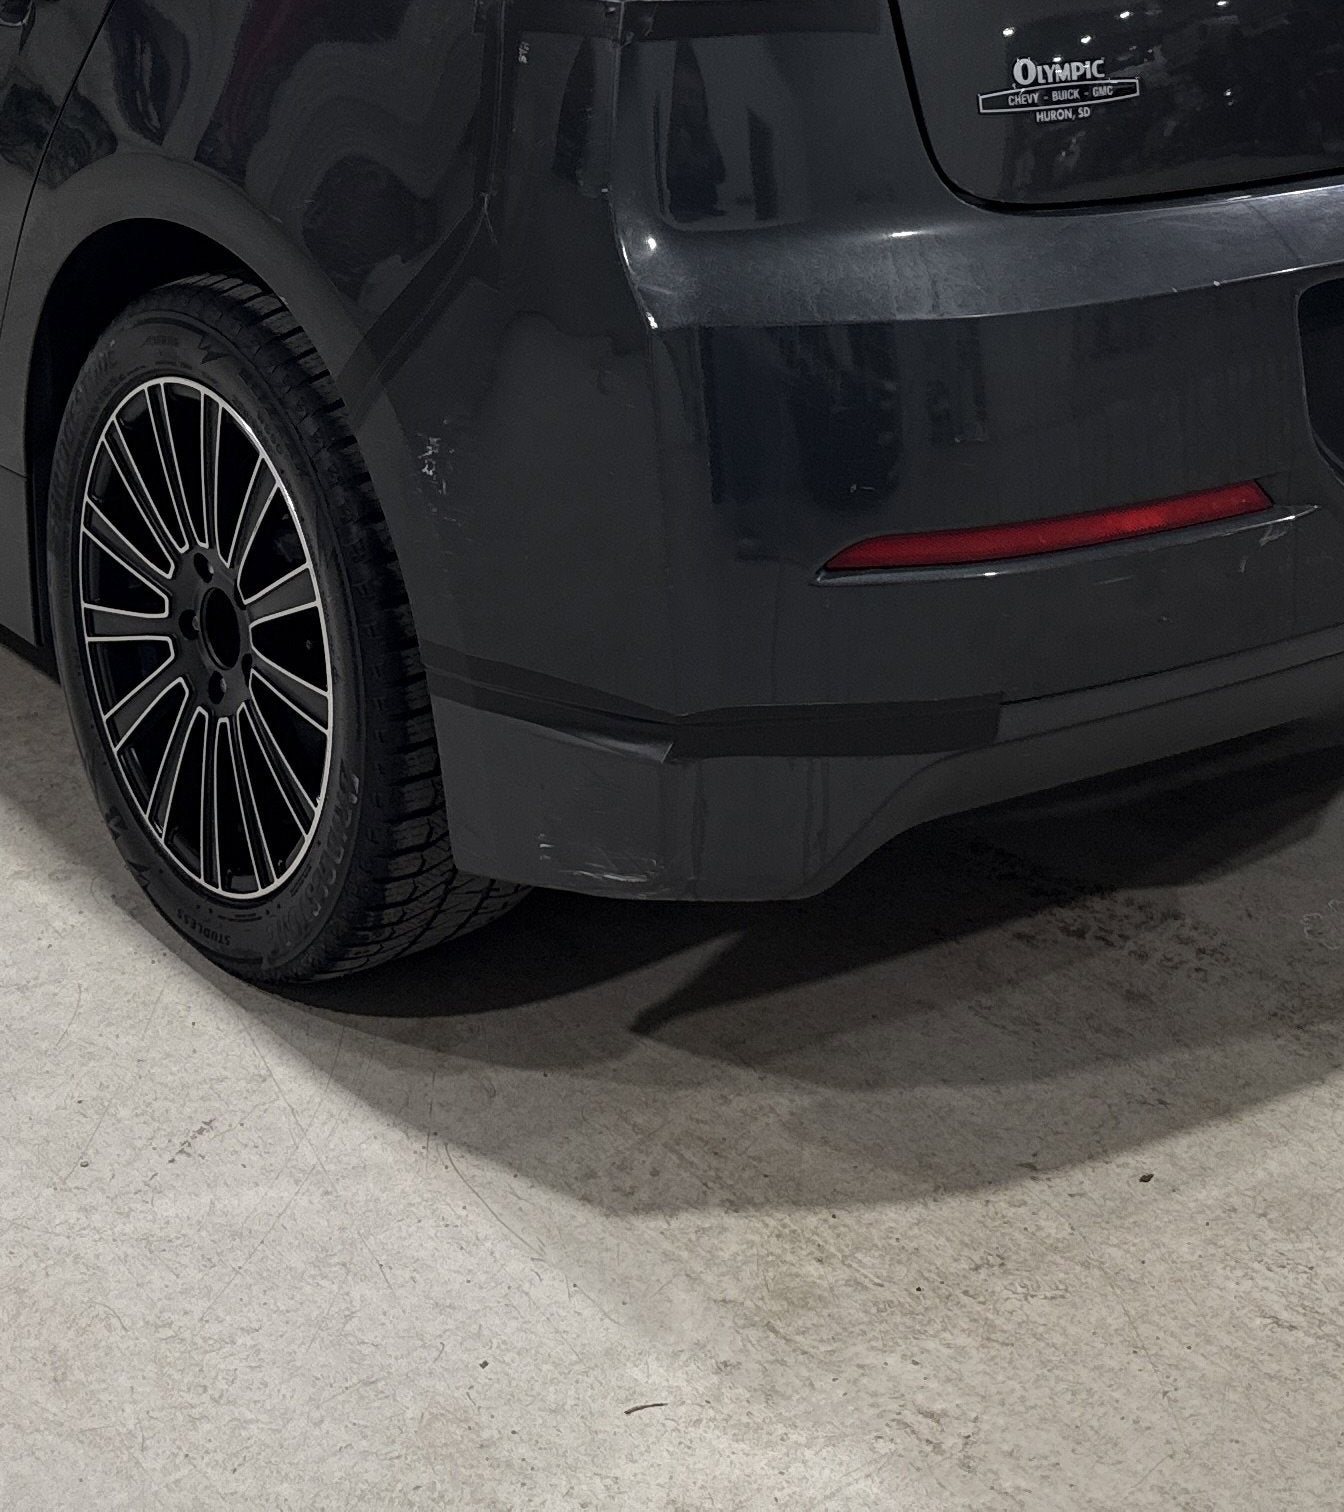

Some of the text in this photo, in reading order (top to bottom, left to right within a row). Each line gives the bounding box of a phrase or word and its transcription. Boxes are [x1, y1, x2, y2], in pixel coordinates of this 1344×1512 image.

[1008, 90, 1040, 106] CHEVY
[1051, 89, 1081, 102] BUICK
[1092, 85, 1114, 98] GMC
[1036, 107, 1091, 123] HURON, SD
[176, 907, 232, 946] STUDLESS
